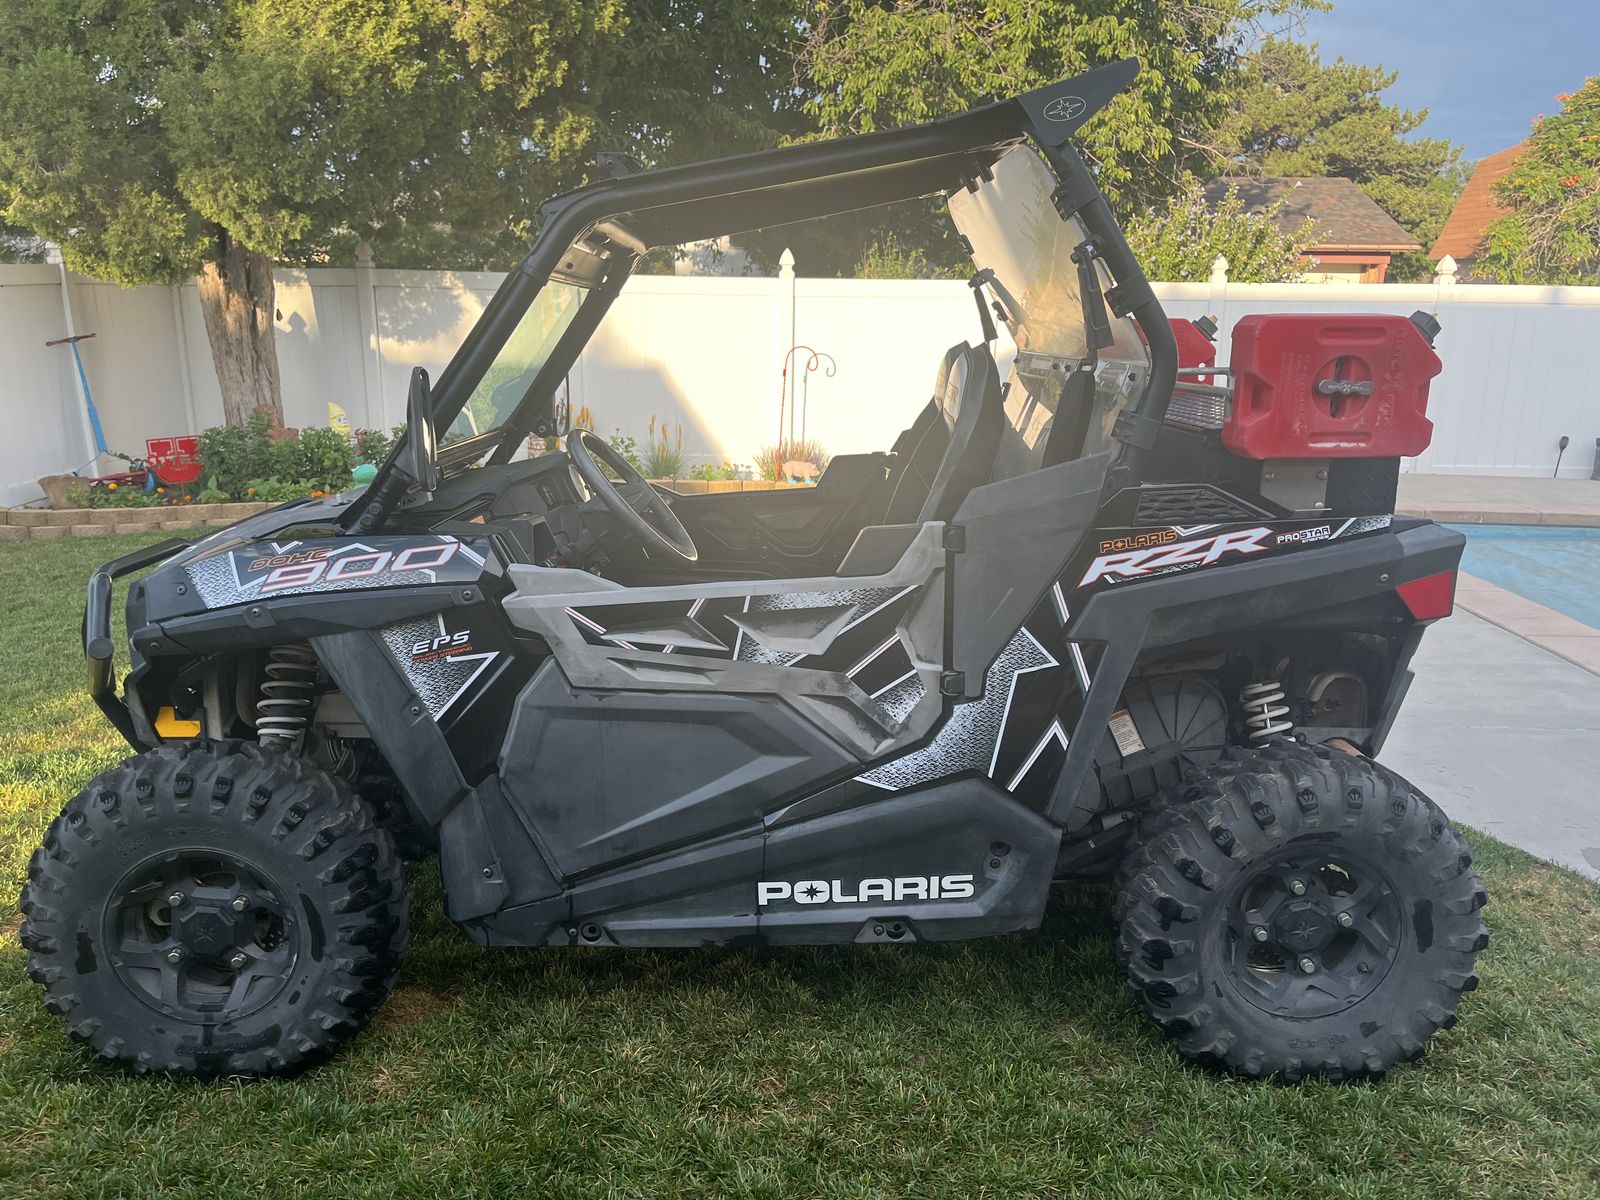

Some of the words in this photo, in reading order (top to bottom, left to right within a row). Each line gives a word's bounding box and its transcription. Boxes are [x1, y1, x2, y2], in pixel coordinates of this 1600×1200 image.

[1100, 530, 1178, 553] POLARIS
[1276, 525, 1330, 545] PROSTAR
[247, 547, 333, 572] DOHC
[260, 541, 461, 593] 900
[1076, 526, 1275, 589] RZR
[412, 630, 470, 654] EPS
[757, 874, 975, 906] POLARIS
